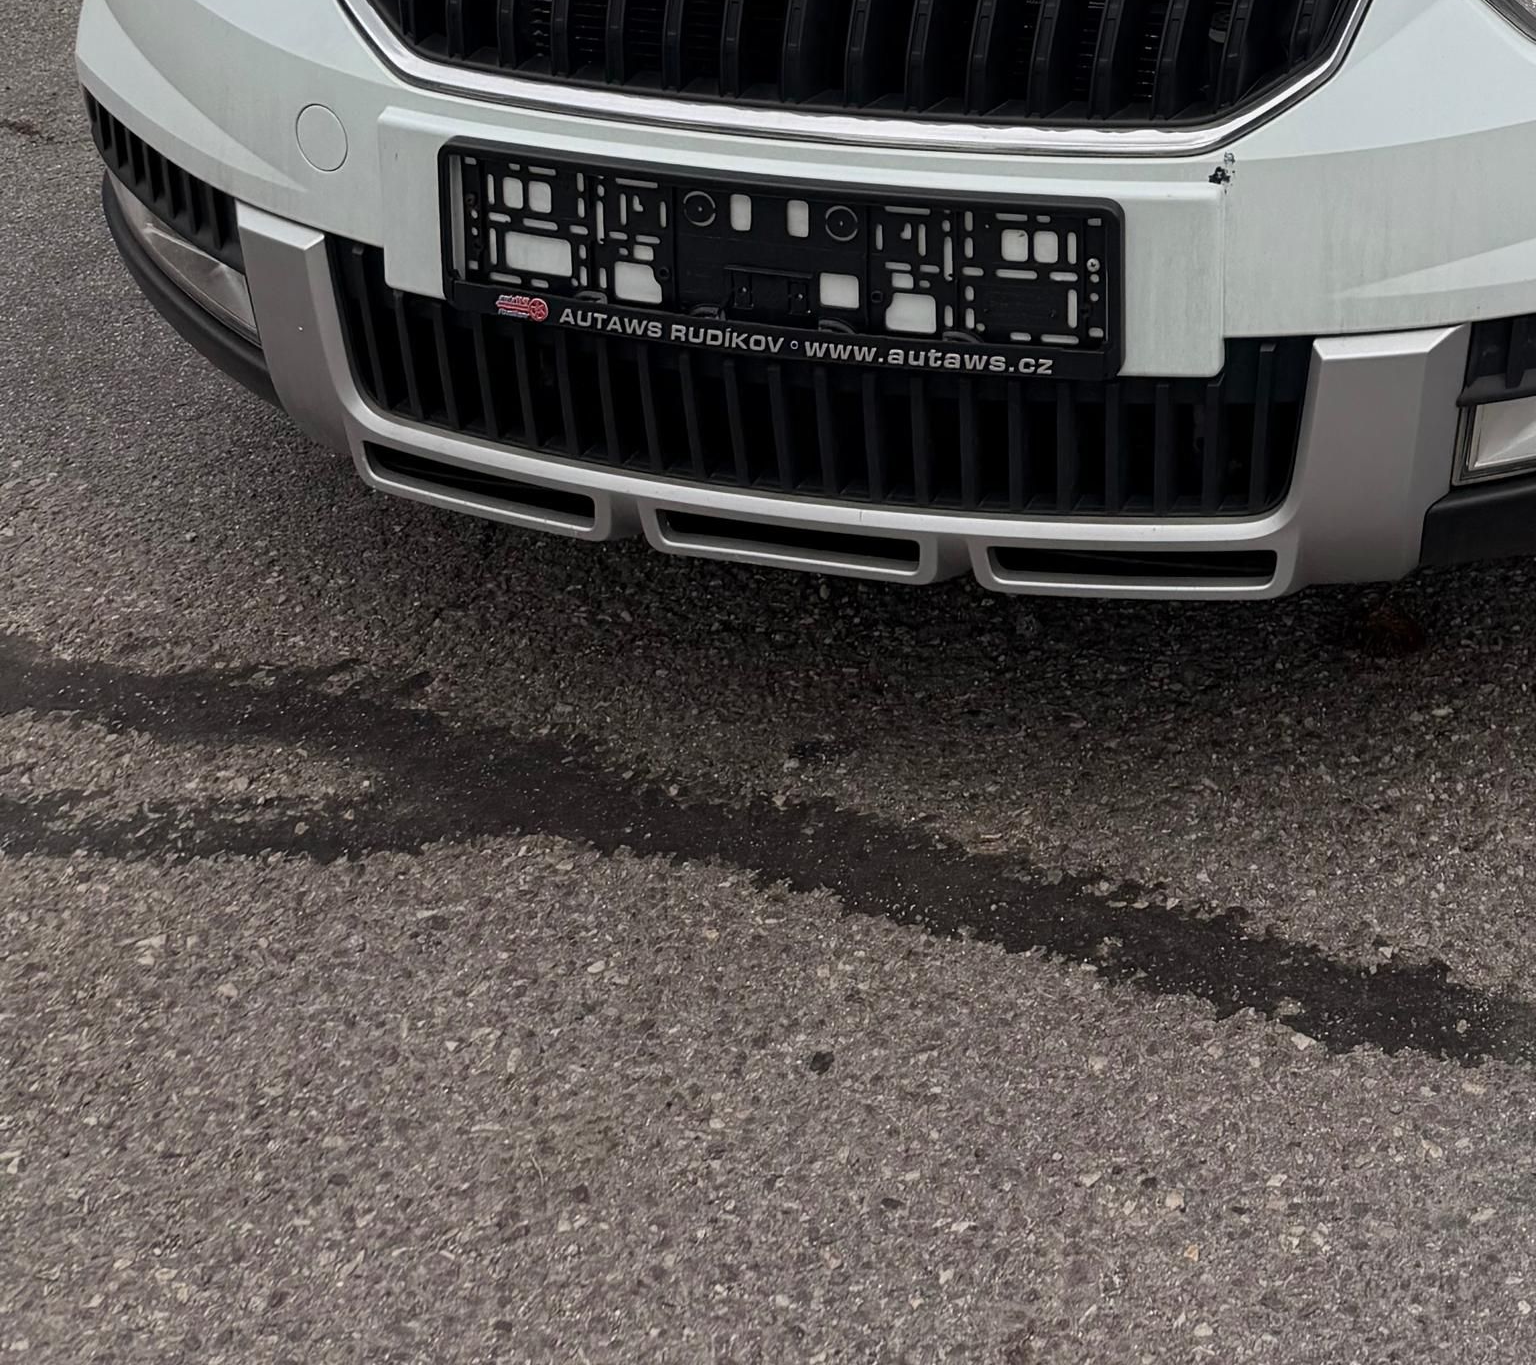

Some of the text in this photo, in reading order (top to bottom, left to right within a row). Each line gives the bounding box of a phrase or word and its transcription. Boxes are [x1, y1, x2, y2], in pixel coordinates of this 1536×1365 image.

[559, 307, 1054, 375] AUTAWS RUDÍKOV www.autaws.cz
